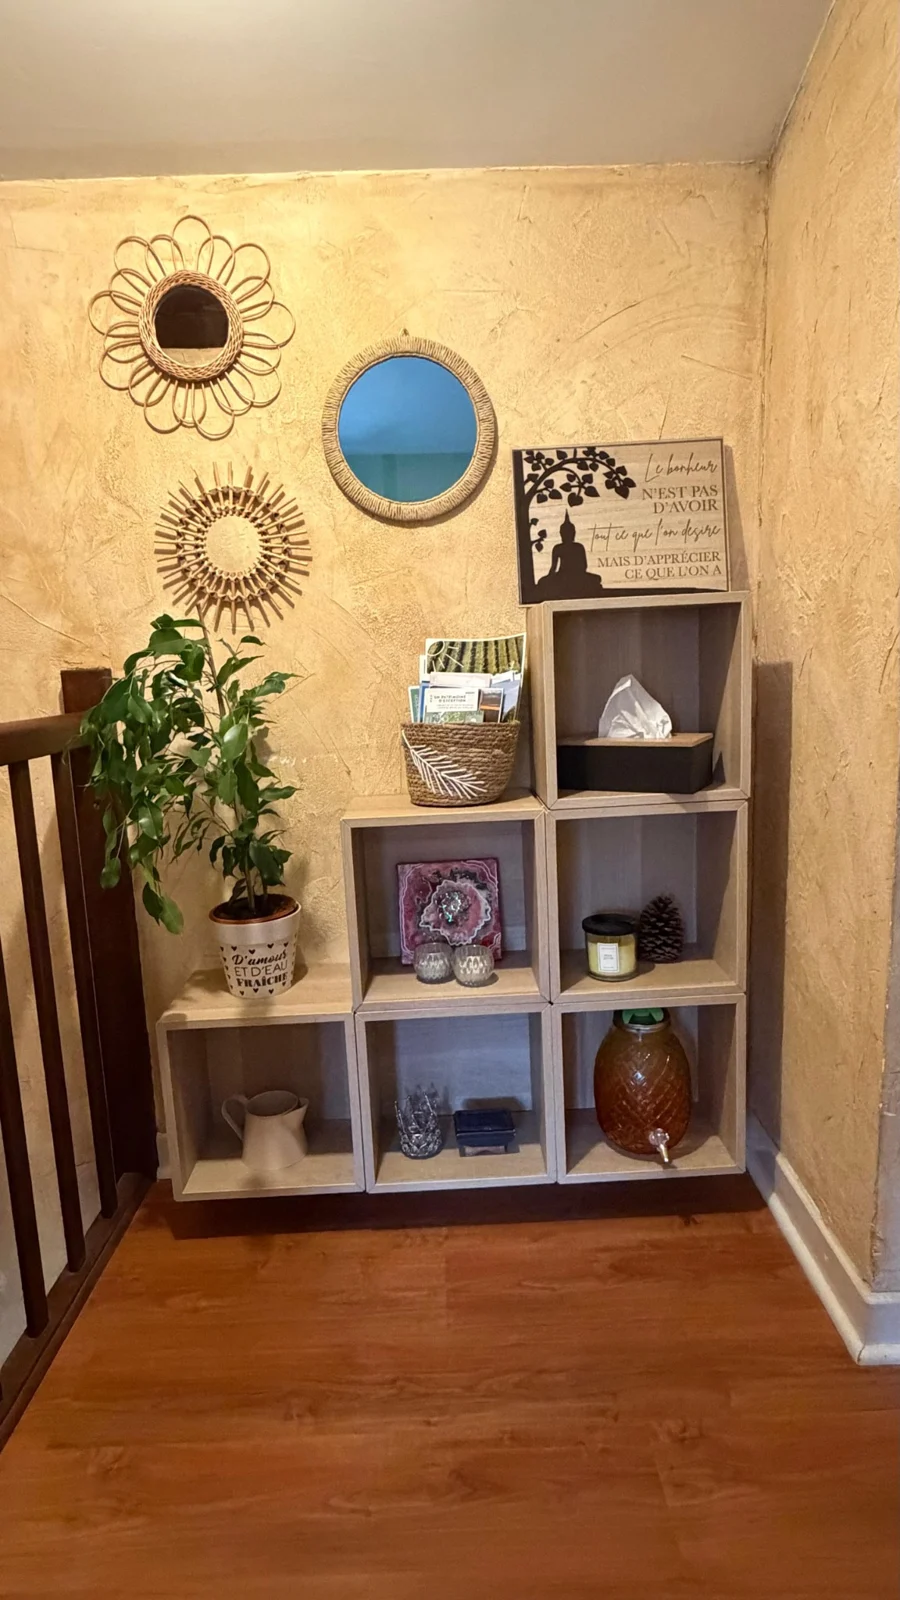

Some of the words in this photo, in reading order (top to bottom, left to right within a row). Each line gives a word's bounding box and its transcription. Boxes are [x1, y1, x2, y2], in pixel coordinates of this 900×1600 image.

[645, 453, 663, 482] Le
[666, 452, 718, 476] bonheur
[642, 486, 687, 500] N'EST
[691, 484, 718, 498] PAS
[653, 499, 719, 514] D'AVOIR
[615, 530, 629, 540] ce
[632, 528, 653, 552] que
[655, 518, 678, 546] l'on
[597, 556, 630, 568] MAIS
[634, 551, 721, 566] D'APPRÉCIER
[624, 569, 642, 580] CE
[645, 567, 675, 581] QUE
[679, 565, 709, 577] L'ON
[713, 565, 722, 575] A
[231, 949, 287, 966] D'amour
[234, 966, 248, 977] ET
[251, 960, 288, 977] D'EAU
[236, 972, 288, 988] FRAÎCHE
